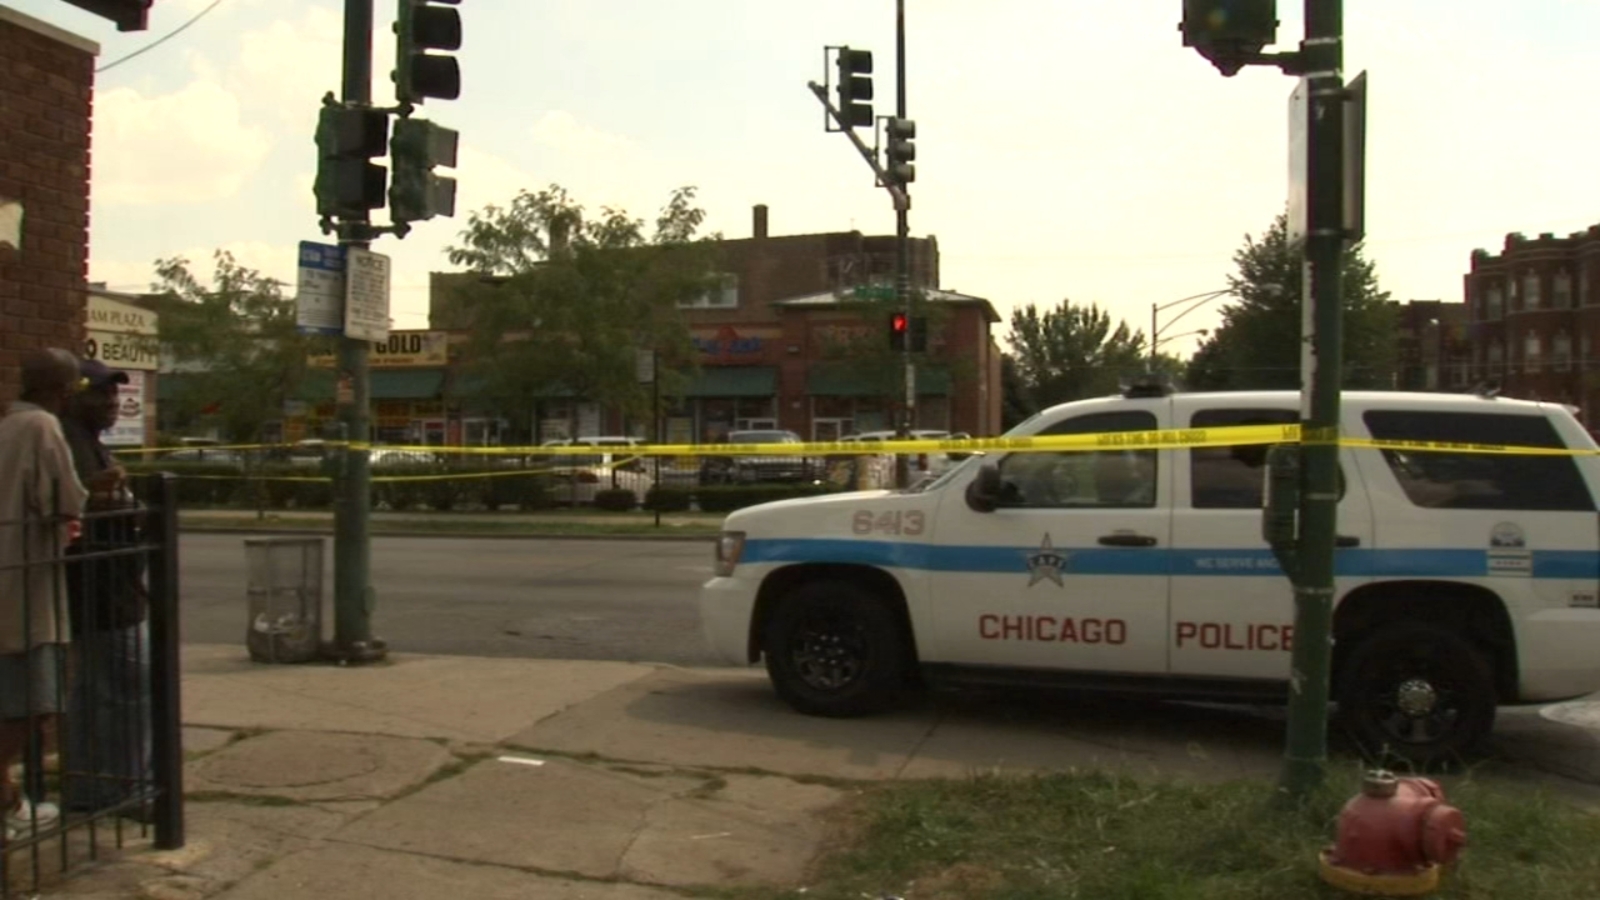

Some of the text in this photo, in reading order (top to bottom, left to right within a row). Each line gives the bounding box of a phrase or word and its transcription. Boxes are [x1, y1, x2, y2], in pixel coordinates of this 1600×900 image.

[109, 311, 145, 327] PLAZA
[102, 342, 157, 363] BEAUTY
[852, 508, 925, 535] 6413
[978, 613, 1294, 652] CHICAGO POLICE
